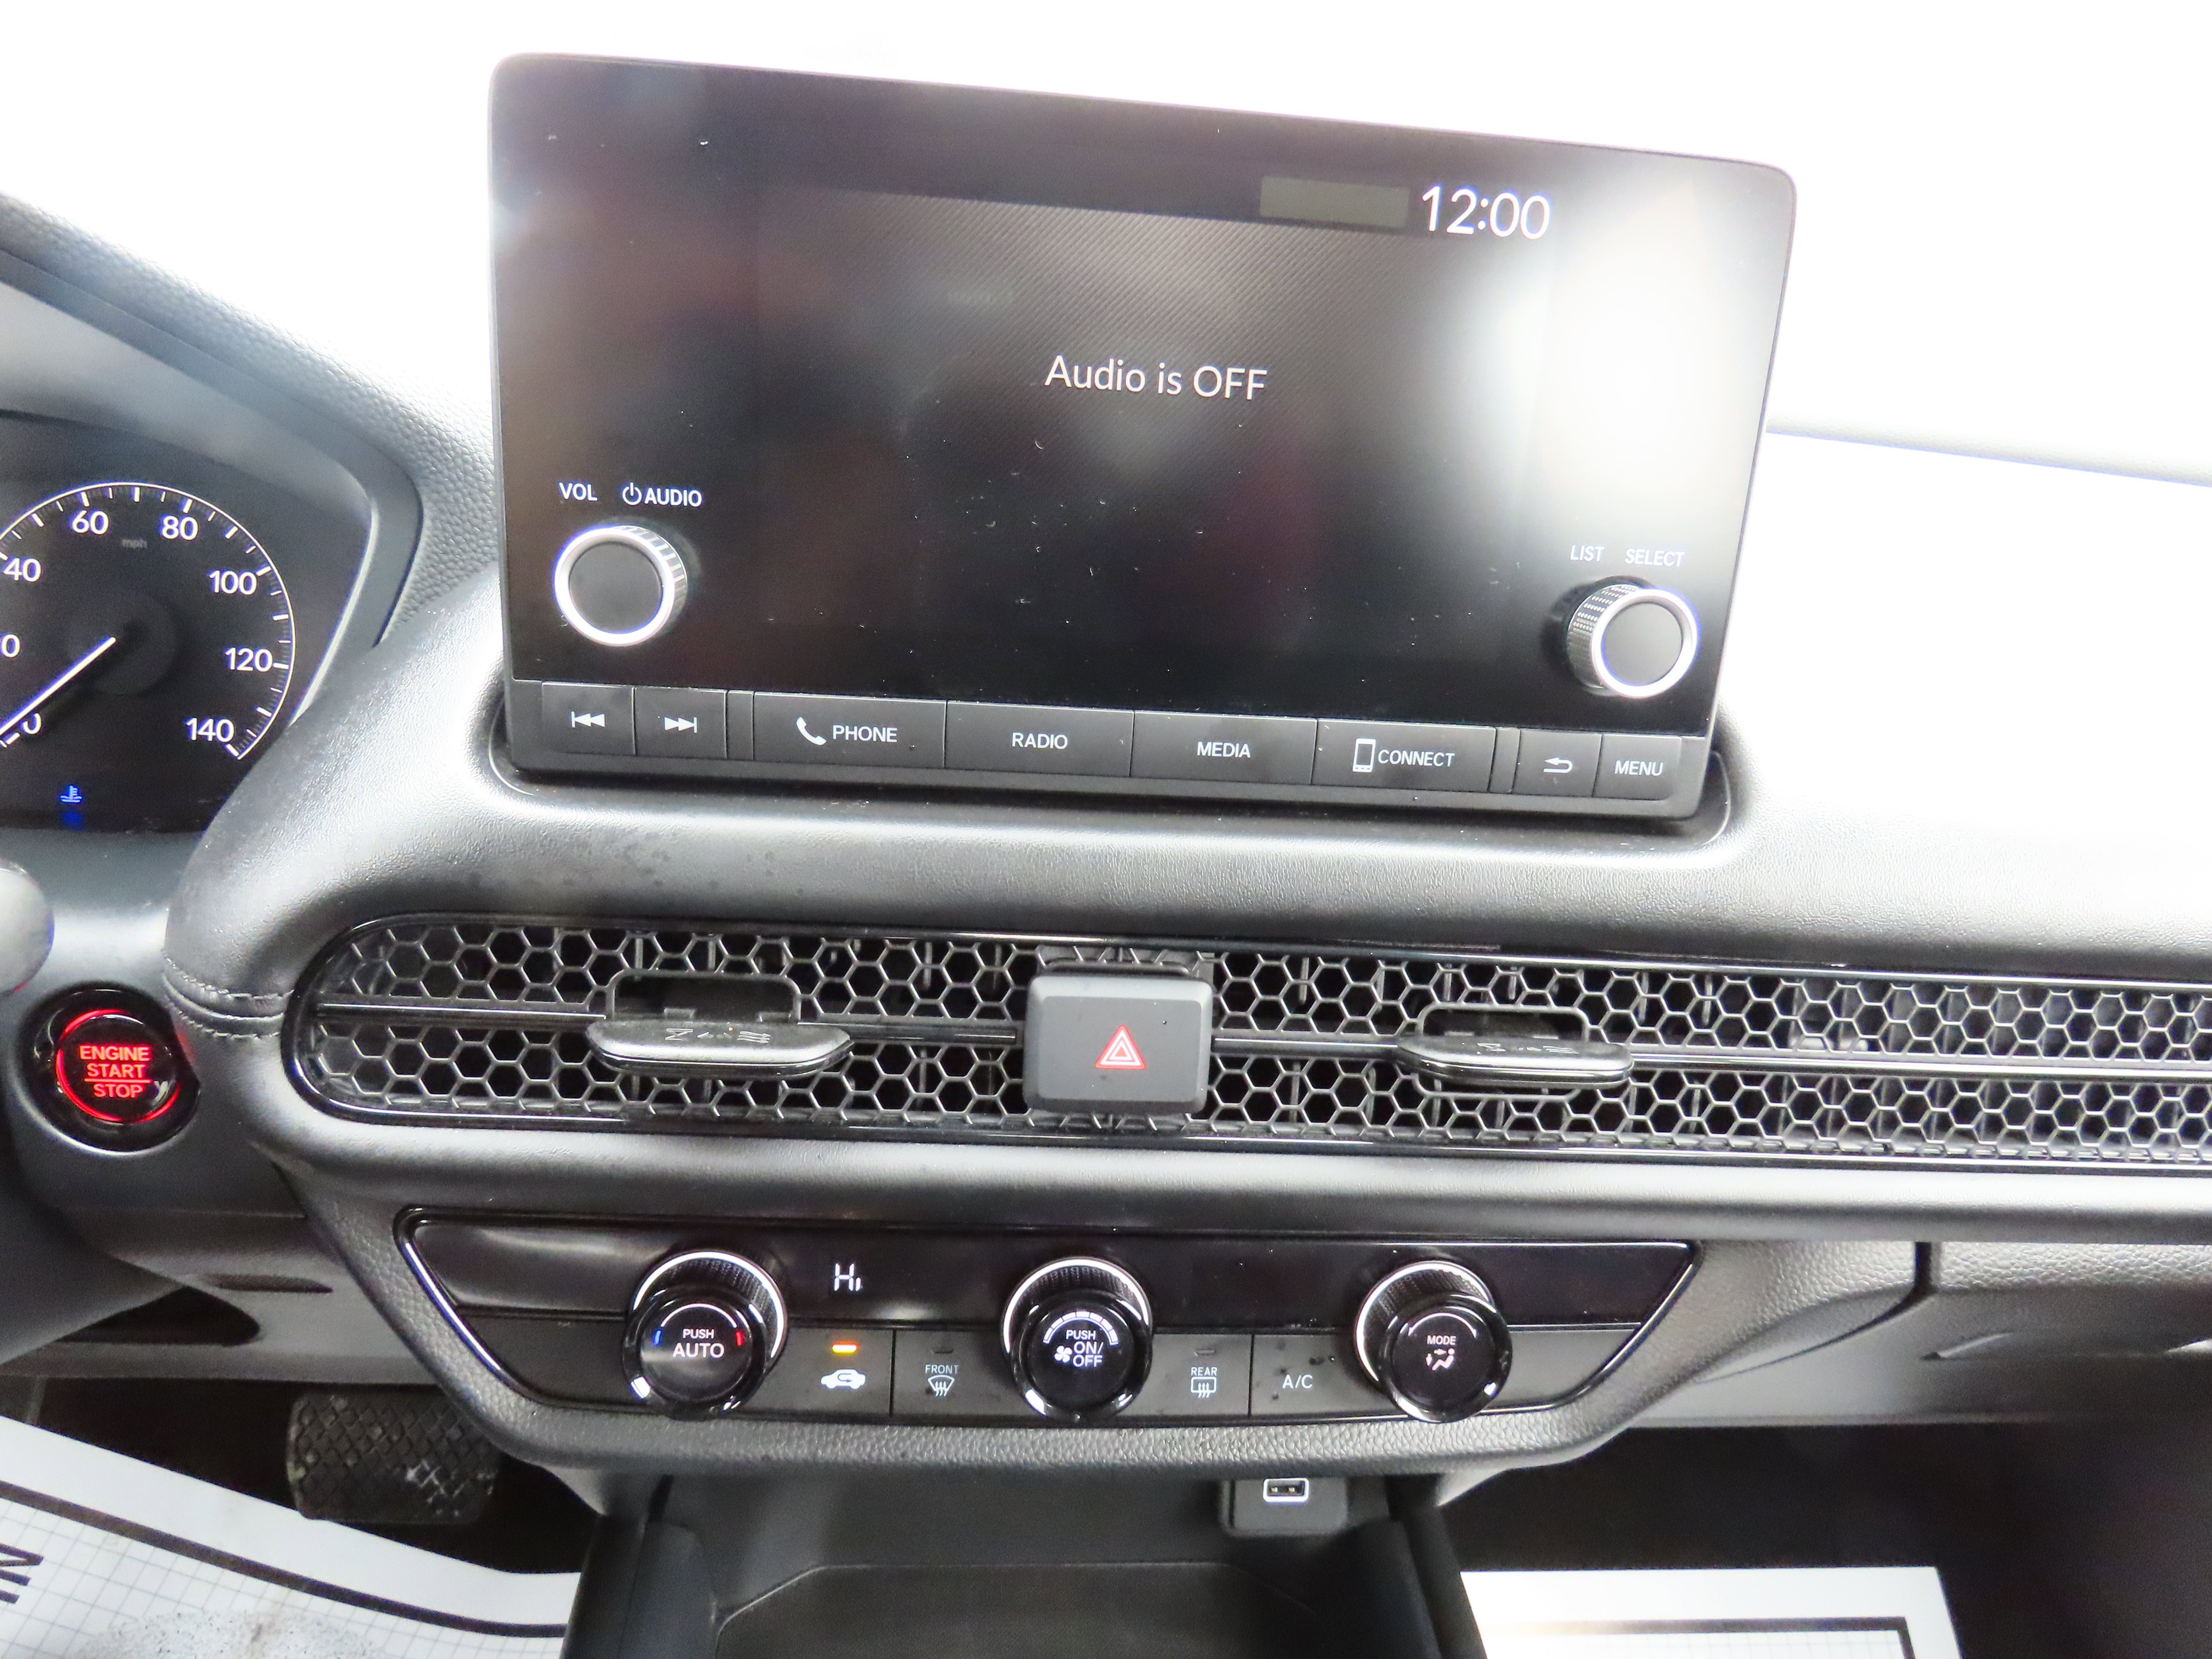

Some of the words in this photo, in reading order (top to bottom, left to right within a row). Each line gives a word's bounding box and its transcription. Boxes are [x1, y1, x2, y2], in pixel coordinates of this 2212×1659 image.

[1422, 186, 1550, 240] 12:00
[1045, 355, 1146, 392] Audio
[1158, 362, 1182, 395] is
[1193, 366, 1268, 400] OFF
[559, 482, 598, 501] VOL
[644, 487, 702, 507] AUDIO
[72, 510, 109, 535] 60
[161, 515, 198, 540] 80
[1570, 544, 1605, 562] LIST
[1624, 548, 1685, 567] SELECT
[3, 557, 41, 582] 40
[209, 570, 257, 595] 100
[0, 634, 20, 658] 0
[225, 647, 273, 672] 120
[186, 718, 235, 742] 140
[832, 725, 898, 743] PHONE
[1012, 732, 1068, 750] RADIO
[1196, 741, 1251, 759] MEDIA
[1378, 749, 1455, 767] CONNECT
[1614, 760, 1664, 777] MENU
[79, 1045, 151, 1061] ENGINE
[87, 1062, 146, 1078] START
[93, 1083, 144, 1098] STOP
[682, 1328, 715, 1339] PUSH
[1066, 1330, 1096, 1340] PUSH
[1426, 1335, 1457, 1346] MODE
[672, 1342, 725, 1358] AUTO
[924, 1364, 958, 1374] FRONT
[1073, 1354, 1103, 1368] OFF
[1190, 1366, 1218, 1377] REAR
[1281, 1374, 1313, 1389] A/C
